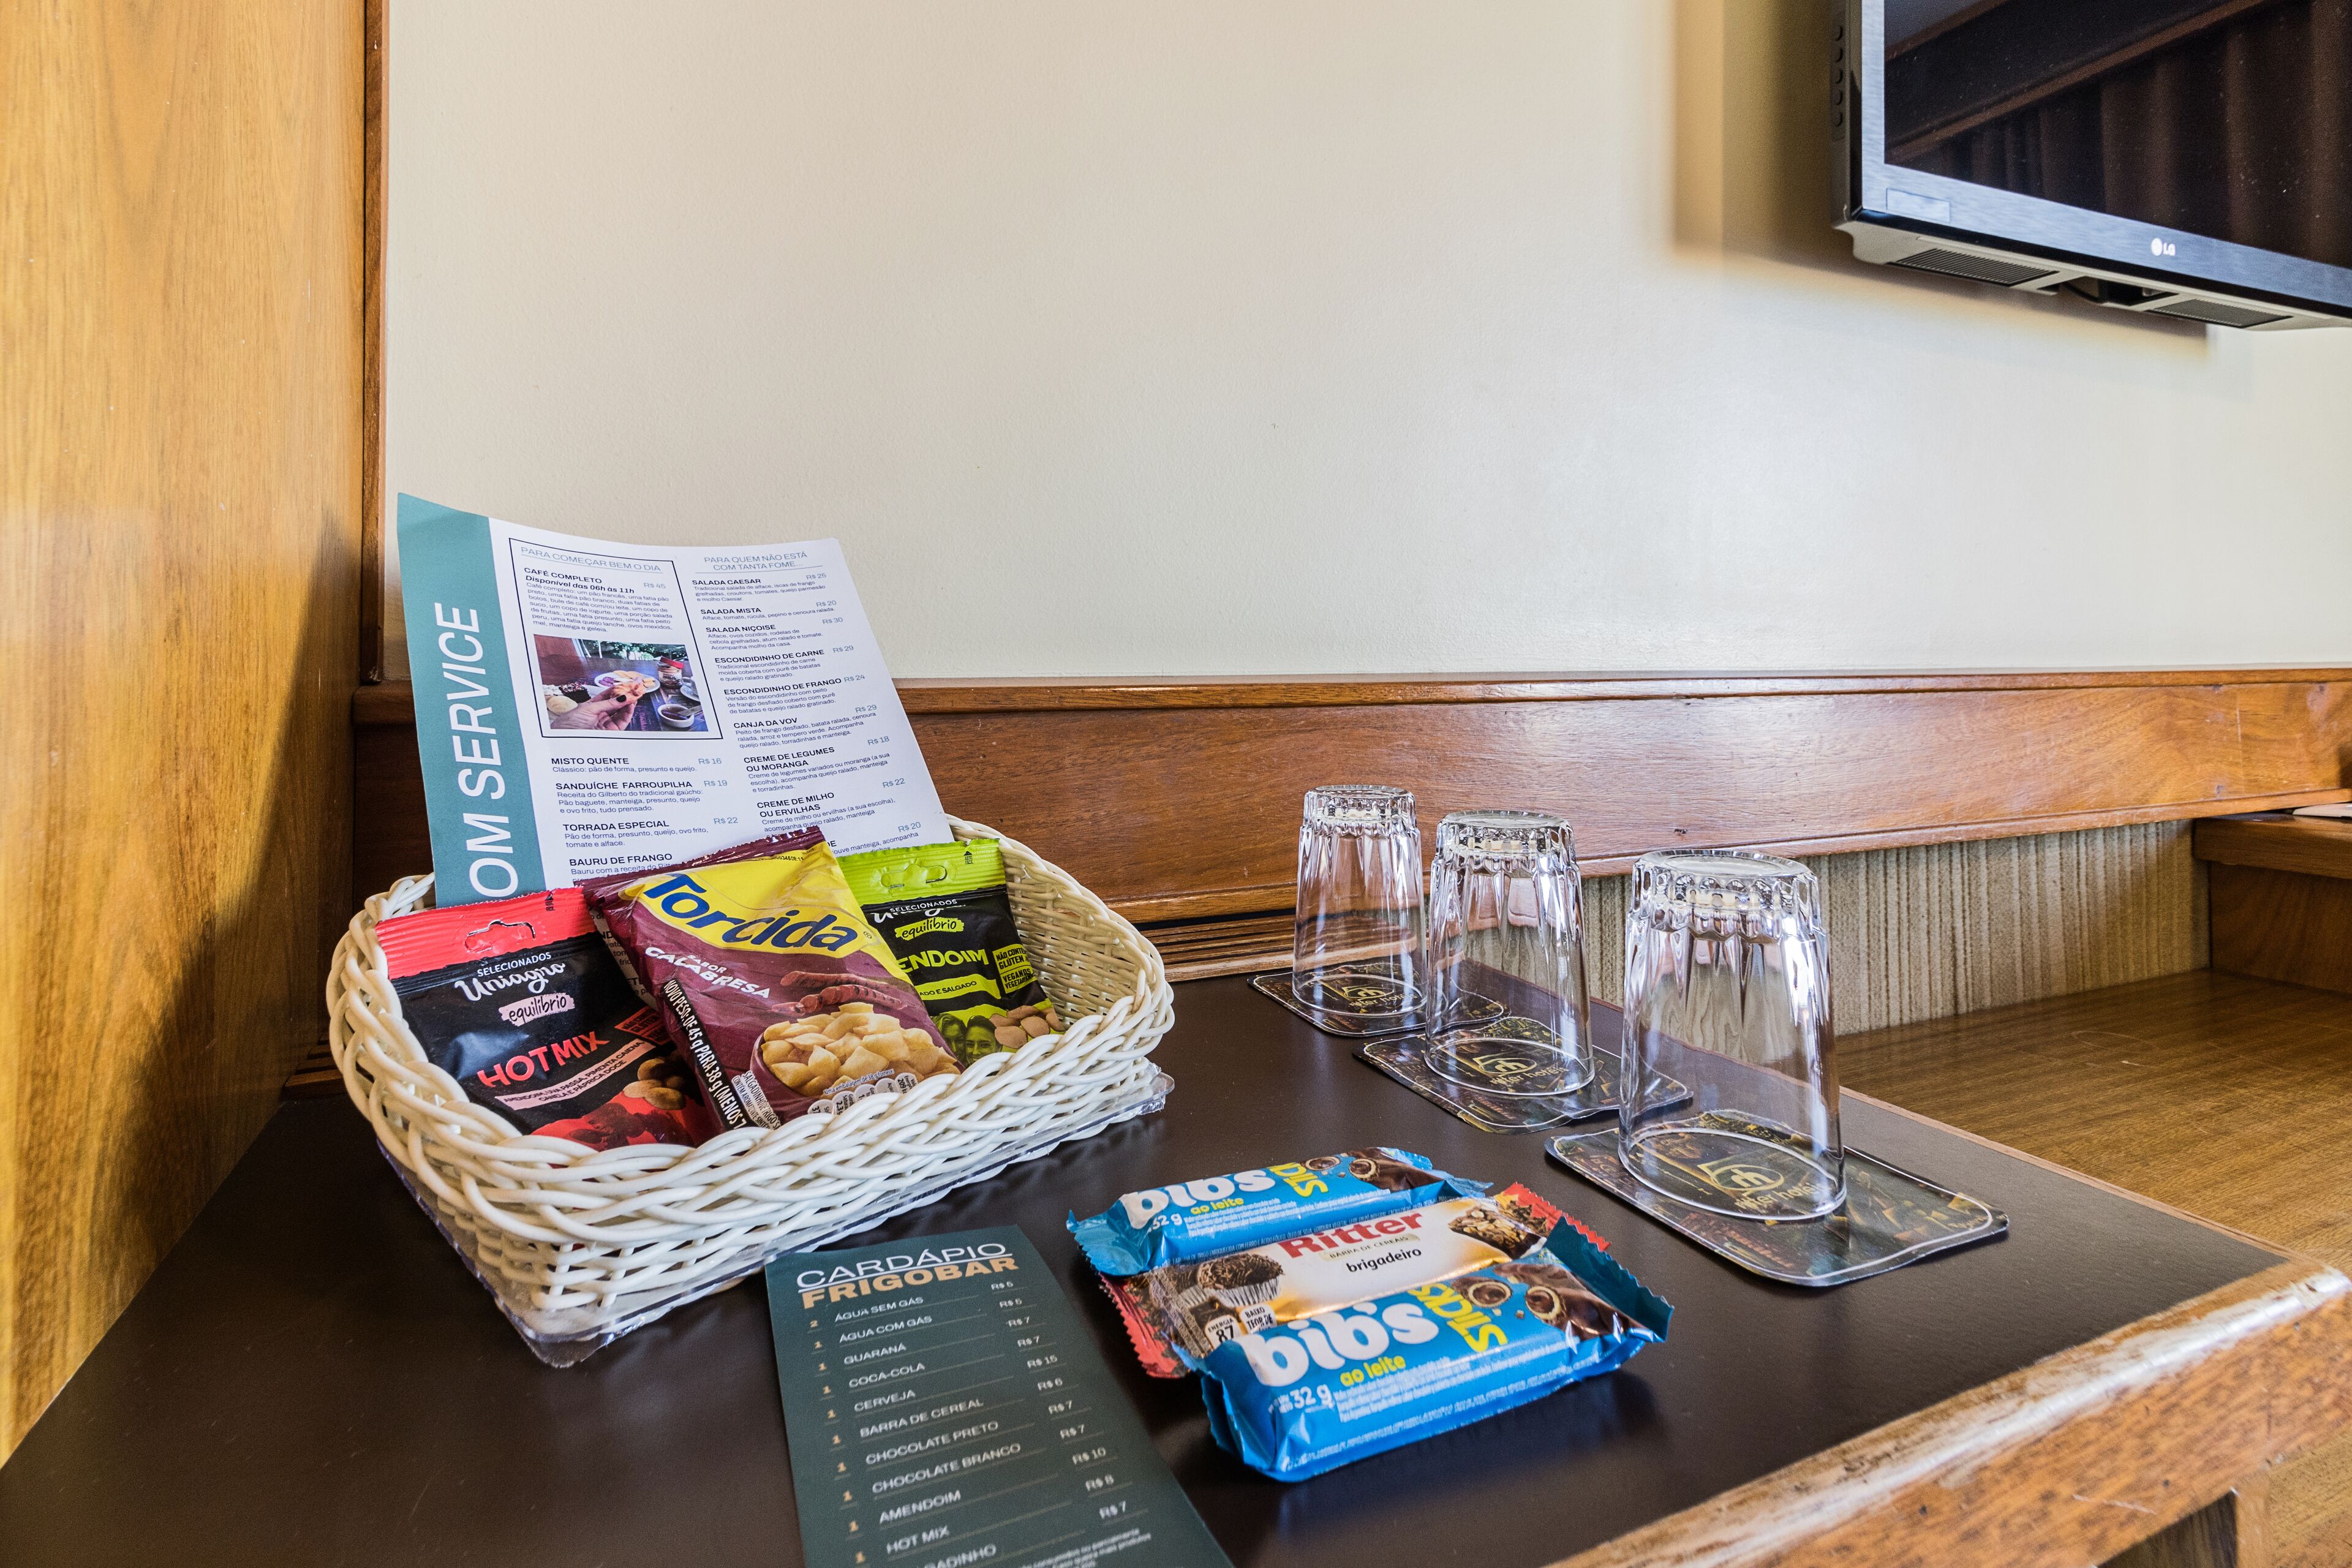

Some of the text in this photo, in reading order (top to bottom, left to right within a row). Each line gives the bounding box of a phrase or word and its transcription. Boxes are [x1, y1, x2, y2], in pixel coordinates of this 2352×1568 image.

[521, 547, 551, 558] PARA
[552, 553, 606, 567] COMEÇAR
[524, 568, 602, 583] CAFÉ COMPLETO
[526, 575, 570, 587] Disponível
[715, 654, 780, 663] ESCONDIDINHO
[796, 649, 824, 658] CARNE
[724, 685, 791, 695] ESCONDIDINHO
[806, 678, 842, 688] FRANGO
[434, 602, 505, 800] SERVICE
[792, 747, 835, 758] LEGUMES
[761, 759, 809, 770] MORANGA
[757, 799, 791, 809] CREME
[806, 791, 834, 803] MILHO
[775, 804, 821, 816] ERVILHAS
[823, 807, 846, 816] ervilhas
[619, 820, 669, 829] ESPECIAL
[570, 858, 607, 867] BAURU
[628, 854, 673, 863] FRANGO
[643, 873, 858, 952] Torcida
[889, 899, 957, 913] SELECIONADOS
[902, 917, 957, 938] equilíbrio
[477, 952, 551, 977] SELECIONADOS
[688, 955, 727, 973] SABOR
[996, 951, 1008, 962] NÃO
[999, 955, 1025, 970] GLÚTEN
[454, 963, 566, 1001] Uniagro
[645, 947, 770, 999] CALABRESA
[1003, 968, 1031, 983] VEGANOS
[943, 981, 977, 993] SALGADO
[509, 995, 566, 1023] equilíbrio
[477, 1031, 610, 1087] HOT MIX
[663, 980, 743, 1125] NOVO PESO: DE 45 g PARA 38 g (MENOS
[575, 1061, 627, 1091] PÁPRICA DOCE
[586, 1060, 617, 1077] PIMENTA
[1191, 1197, 1245, 1215] ao leite
[1277, 1213, 1422, 1258] Ritter
[1330, 1247, 1360, 1259] BARRA
[1373, 1236, 1409, 1249] CEREAIS
[797, 1243, 1006, 1289] CARDÁPIO
[1346, 1248, 1422, 1273] brigadeiro
[802, 1257, 1019, 1310] FRIGOBAR
[835, 1296, 924, 1322] ÁGUA SEM GÁS
[1245, 1306, 1265, 1318] BAIXO
[839, 1316, 933, 1343] ÁGUA COM GÁS
[1208, 1318, 1234, 1332] ENERGIA
[1246, 1313, 1273, 1330] TEOR DE
[844, 1342, 907, 1365] GUARANÁ
[849, 1362, 925, 1387] COCA-COLA
[1340, 1355, 1406, 1387] ao leite
[854, 1389, 916, 1412] CERVEJA
[1291, 1384, 1333, 1410] 32 g
[860, 1398, 984, 1438] BARRA DE CEREAL
[866, 1421, 998, 1465] CHOCOLATE PRETO
[872, 1443, 1020, 1493] CHOCOLATE BRANCO
[880, 1490, 961, 1524] AMENDOIM
[886, 1525, 949, 1554] HOT MIX
